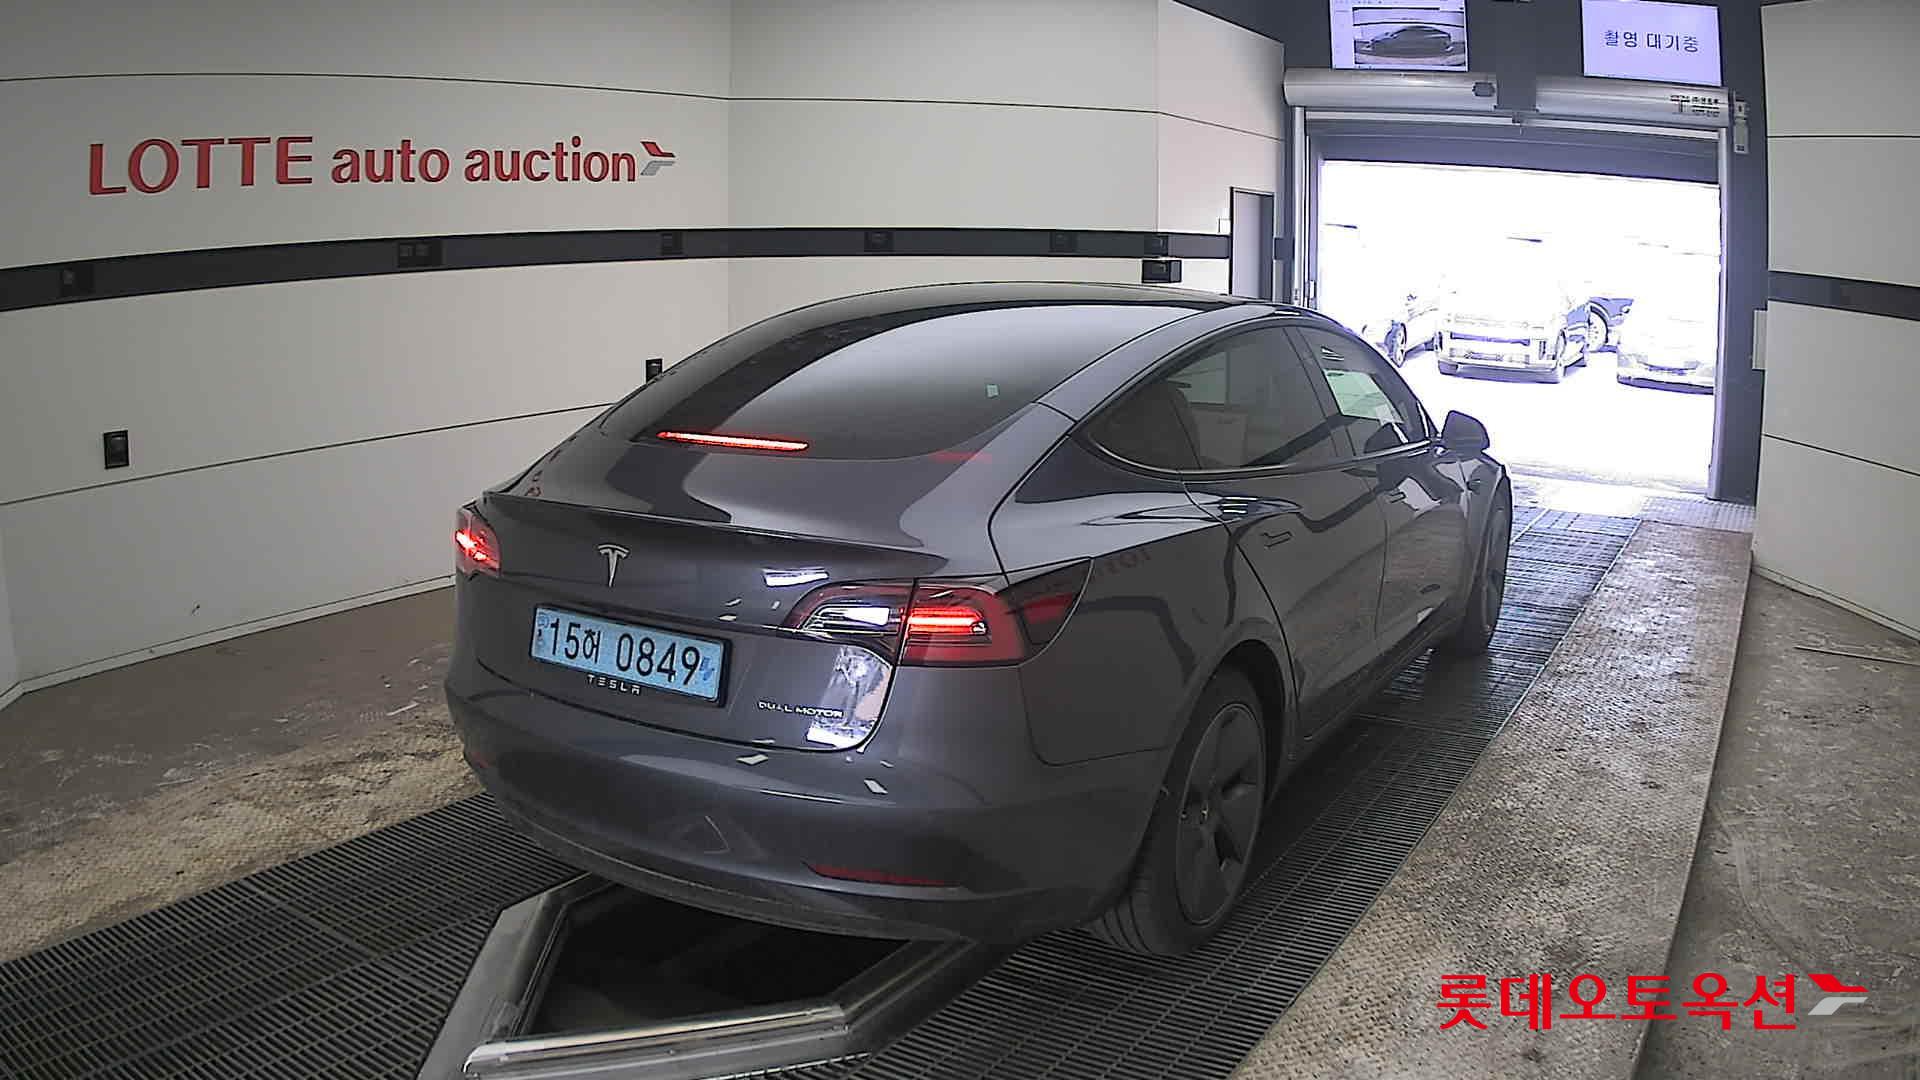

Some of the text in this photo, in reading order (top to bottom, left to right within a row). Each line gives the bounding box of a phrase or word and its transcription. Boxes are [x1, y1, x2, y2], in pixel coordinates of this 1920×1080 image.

[1646, 32, 1698, 53] 대기중
[88, 136, 637, 195] LOTTE auto auction
[550, 617, 601, 665] 15허
[615, 632, 700, 686] 0849
[586, 673, 641, 696] TESLA
[795, 705, 843, 719] MOTOR
